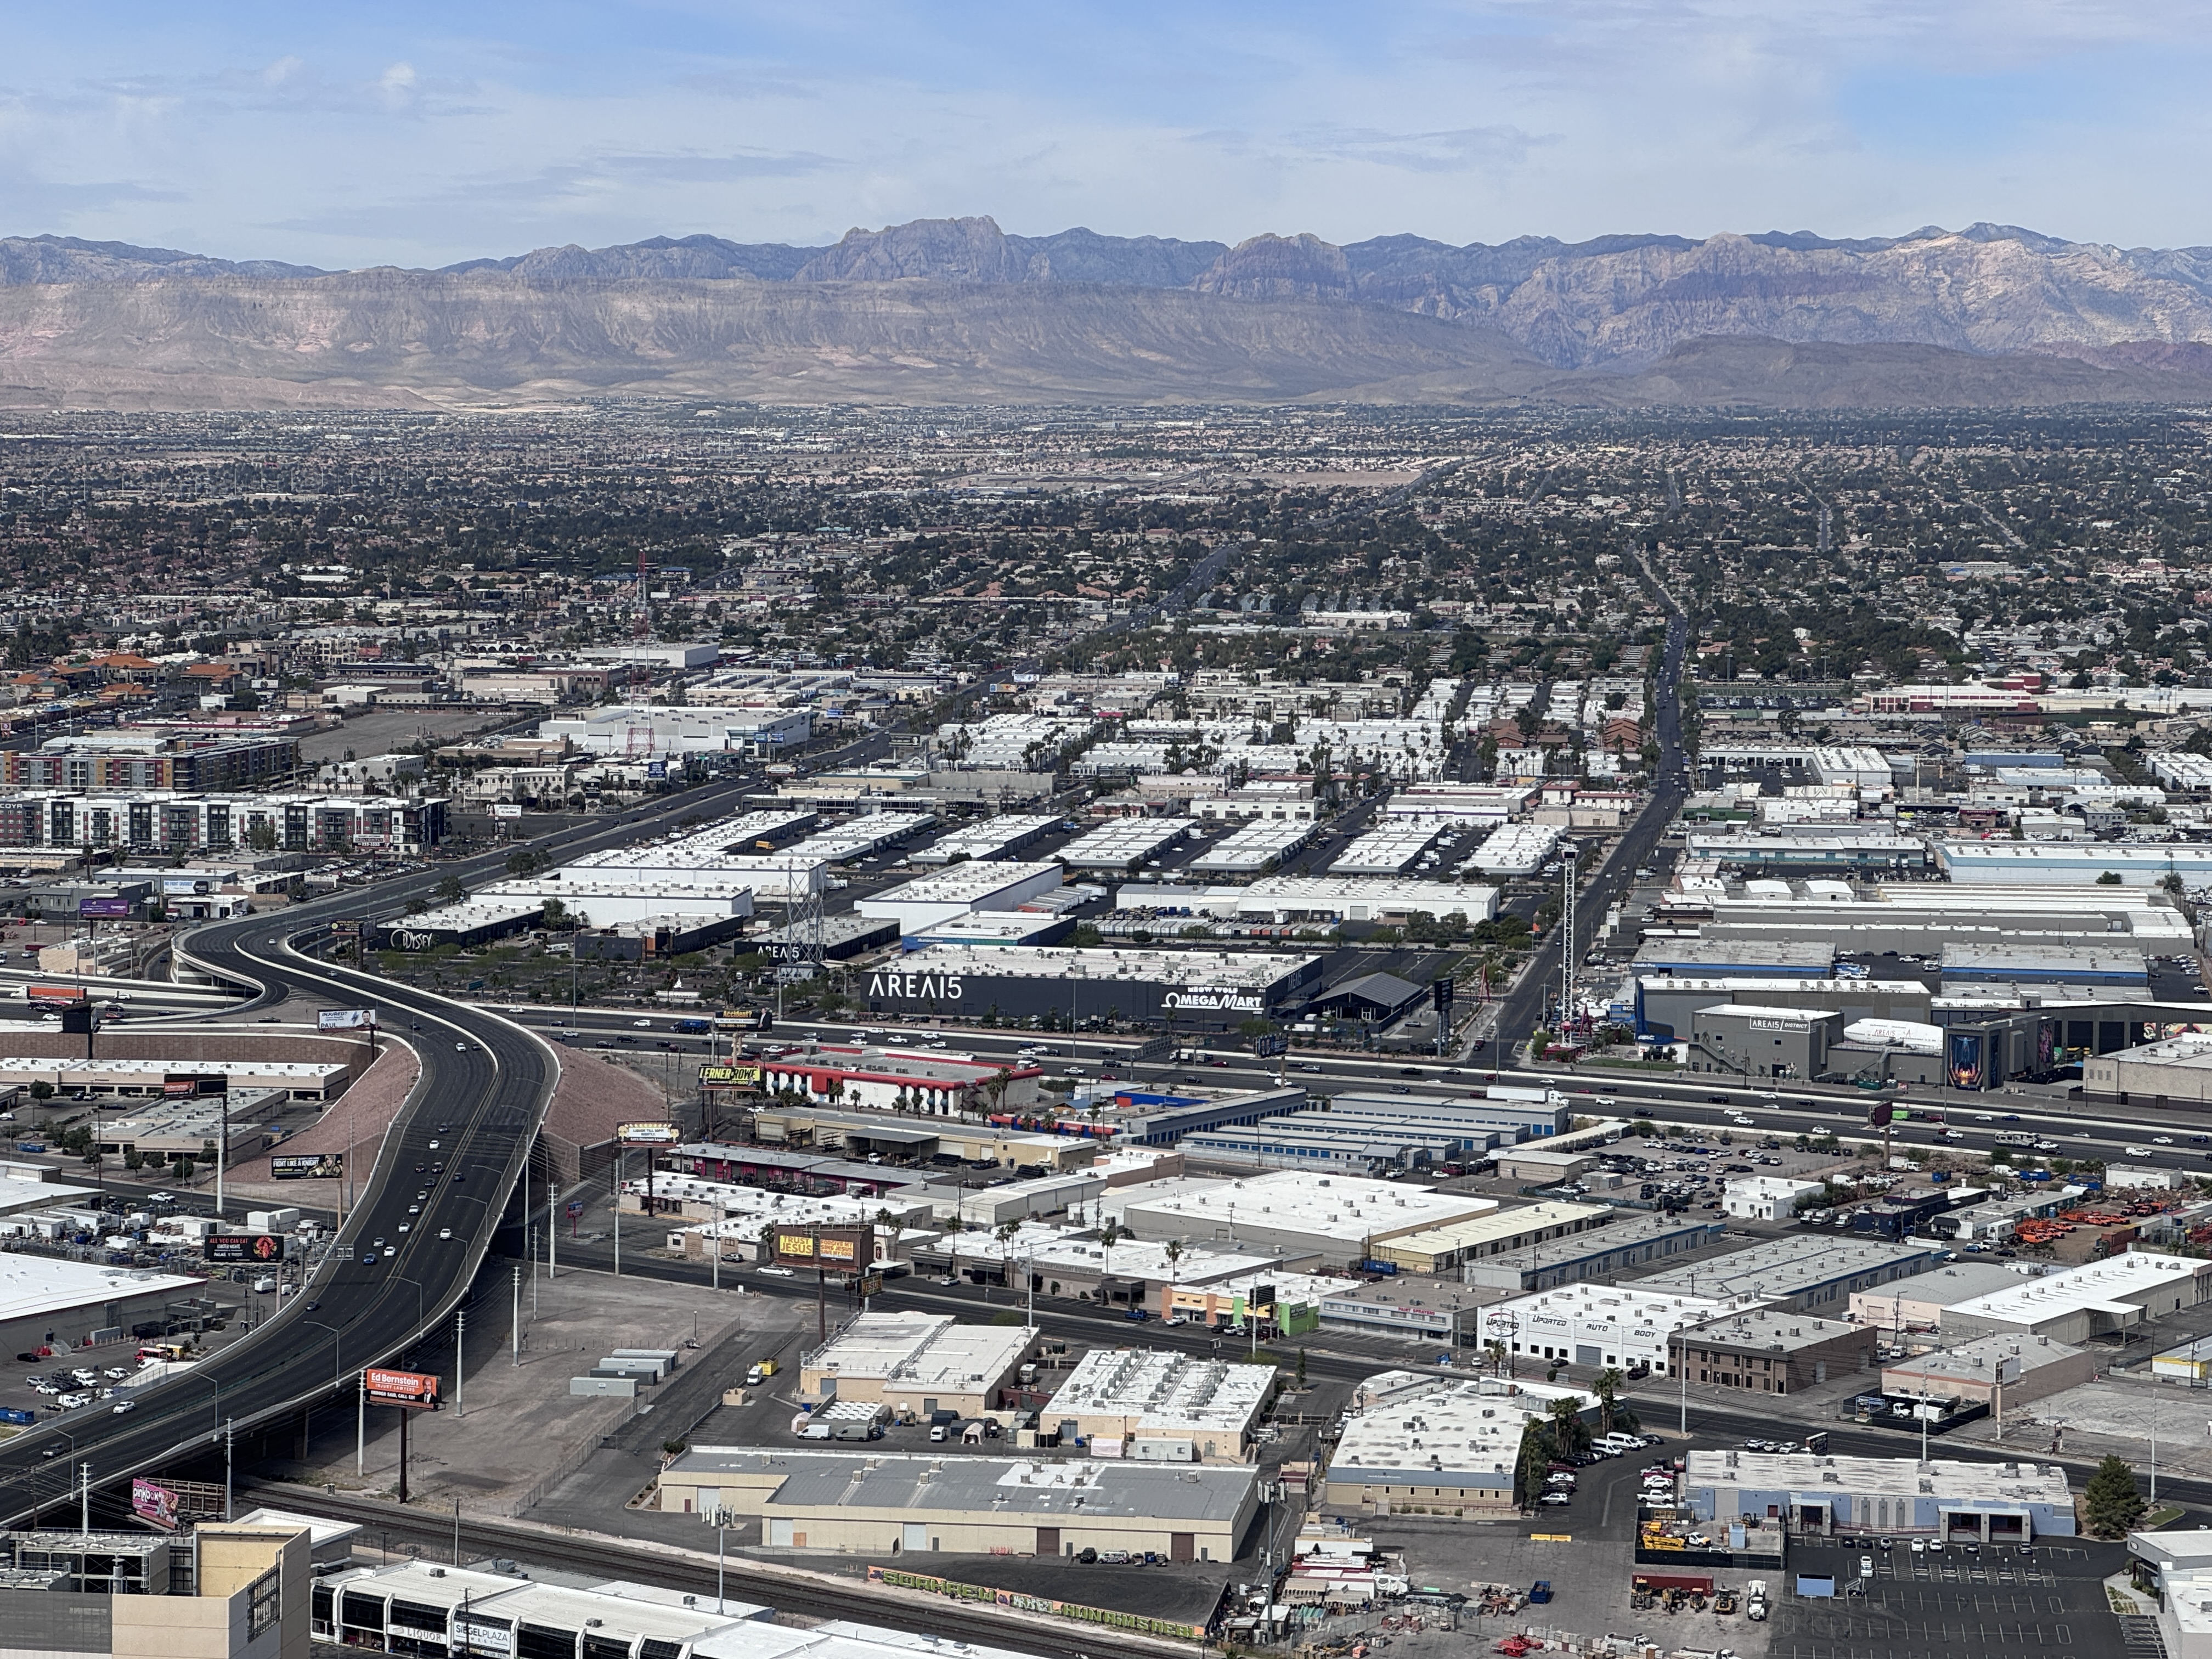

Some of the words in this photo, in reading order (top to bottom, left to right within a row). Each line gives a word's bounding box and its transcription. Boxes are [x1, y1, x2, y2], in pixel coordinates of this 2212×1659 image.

[758, 946, 799, 958] AREA5
[869, 974, 962, 999] AREA15
[1752, 1020, 1780, 1028] AREA15
[699, 1068, 732, 1079] LERNER
[734, 1069, 757, 1080] ROWE
[783, 1237, 810, 1245] TRUST
[780, 1243, 812, 1254] JESUS
[1045, 1262, 1074, 1272] RESTAURANT
[1075, 1267, 1102, 1275] EQUIPMENT
[862, 1280, 881, 1291] JESUS
[1586, 1324, 1609, 1332] AUTO
[371, 1373, 380, 1381] Ed
[382, 1374, 419, 1386] Bernstein
[134, 1484, 159, 1502] pinkbox
[407, 1628, 441, 1642] LIQUOR
